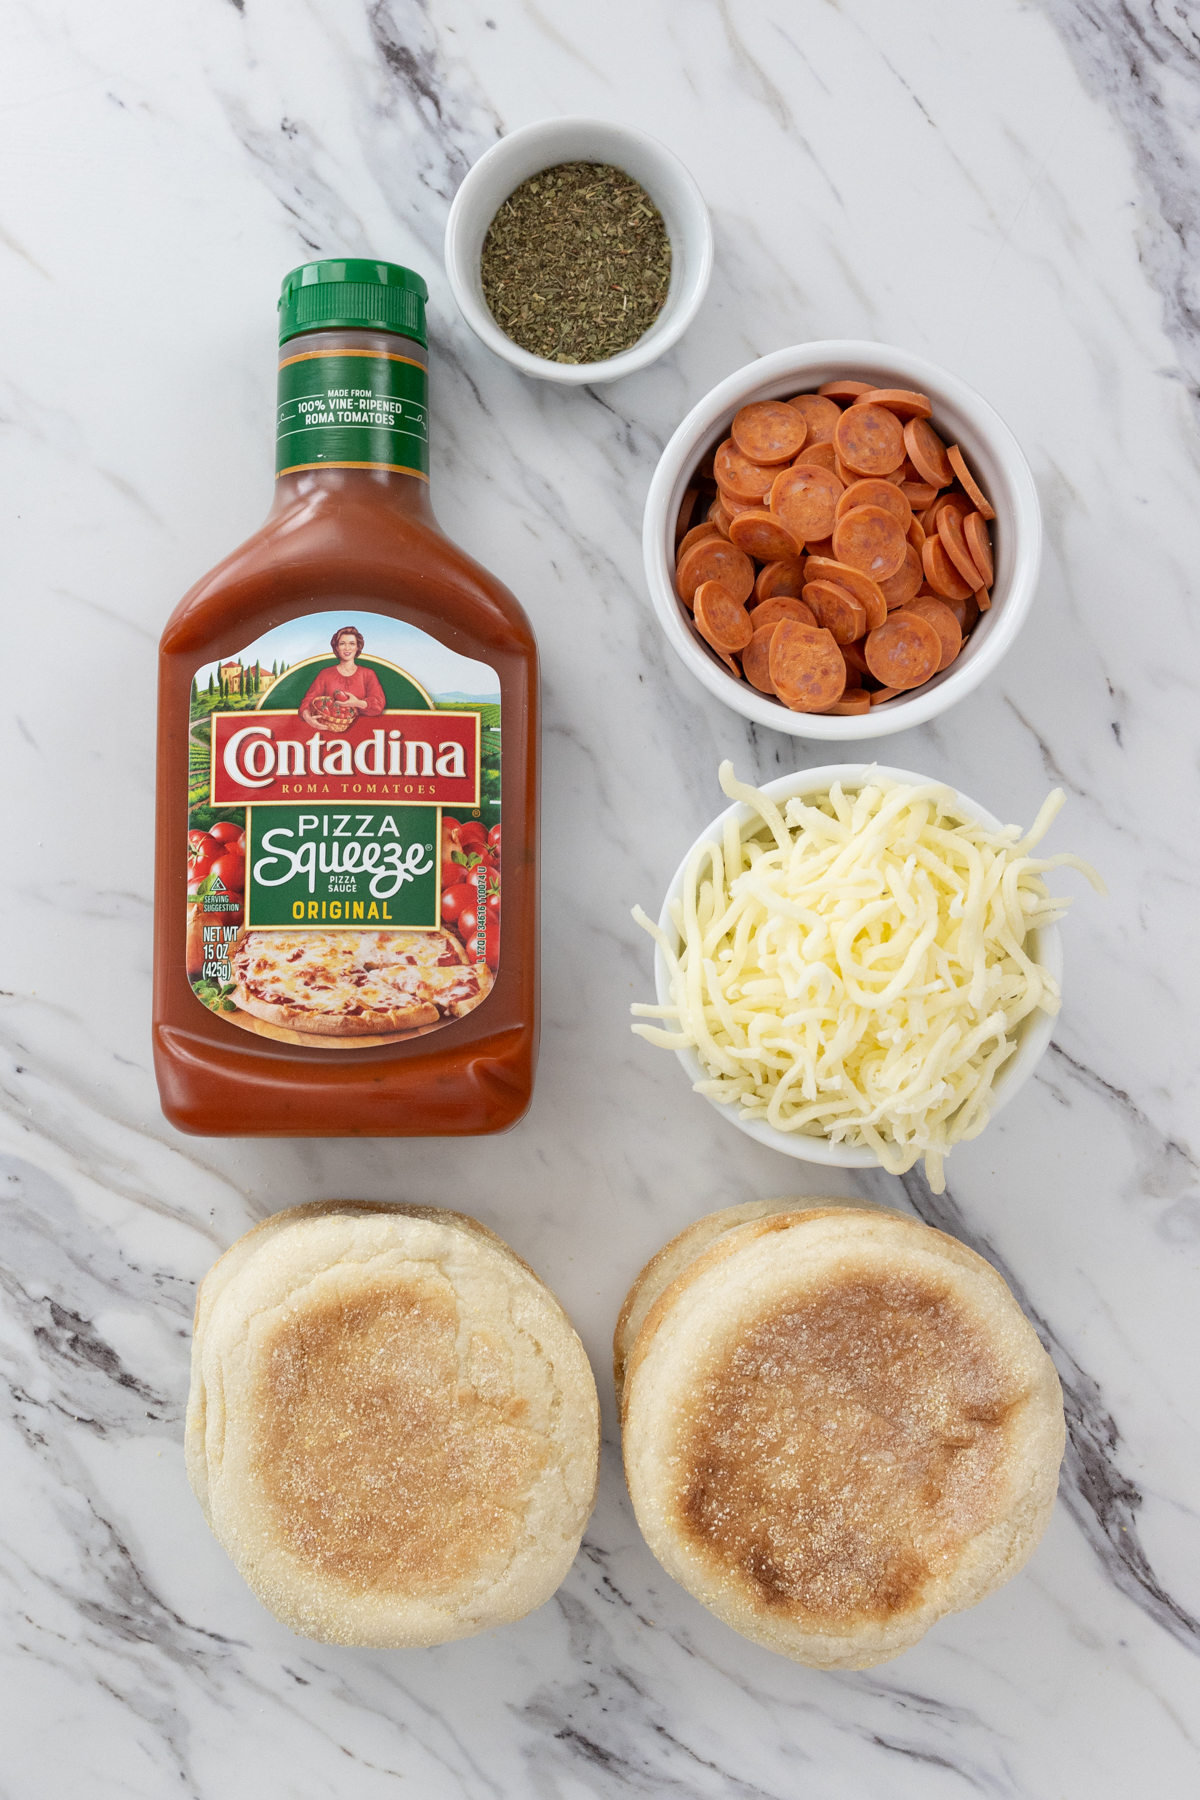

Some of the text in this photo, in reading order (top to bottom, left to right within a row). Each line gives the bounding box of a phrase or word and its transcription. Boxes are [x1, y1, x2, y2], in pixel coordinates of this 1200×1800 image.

[328, 389, 372, 397] MADE FROM
[298, 398, 402, 414] 100% VINE-RIPENED
[306, 412, 394, 425] ROMA TOMATOES
[223, 726, 466, 788] Contadina
[282, 784, 436, 794] ROMA TOMATOES
[298, 815, 400, 837] PIZZA
[253, 828, 433, 899] Squeeze
[328, 884, 357, 892] SAUCE
[330, 876, 356, 884] PIZZA
[204, 895, 229, 903] SERVING
[204, 904, 240, 912] SUGGESTION
[292, 901, 392, 920] ORIGINAL
[203, 926, 238, 942] NET WT
[203, 944, 229, 960] 15 OZ
[477, 940, 486, 956] TZQ
[202, 961, 232, 980] (425g)
